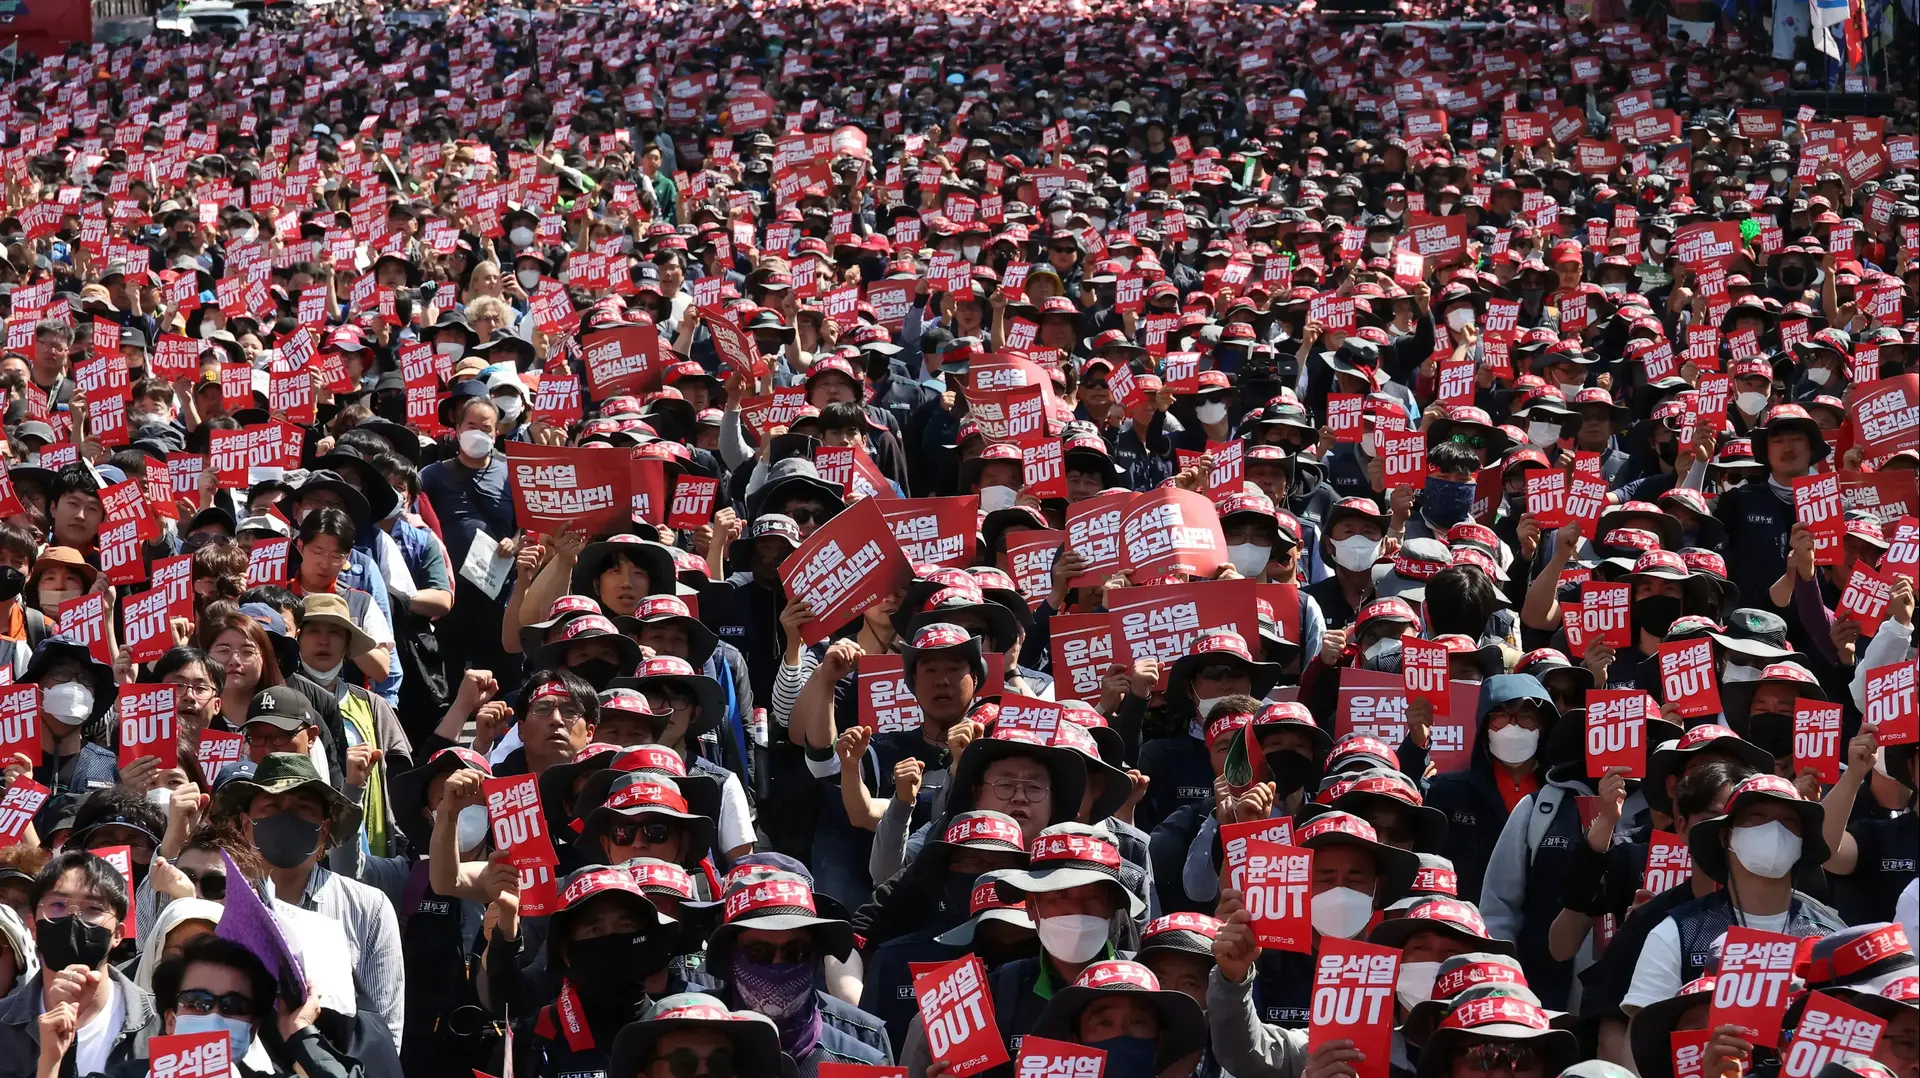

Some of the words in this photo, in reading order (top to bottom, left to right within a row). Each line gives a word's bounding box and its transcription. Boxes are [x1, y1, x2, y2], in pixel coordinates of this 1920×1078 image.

[766, 238, 790, 252] OUT
[897, 229, 920, 243] OUT
[793, 271, 814, 288] OUT
[830, 299, 856, 316] OUT
[1117, 291, 1141, 304] OUT
[1486, 316, 1515, 331] OUT
[1007, 333, 1032, 349] OUT
[1145, 331, 1167, 346] OUT
[1690, 341, 1716, 358] OUT
[402, 345, 432, 364] 윤석열
[1643, 343, 1672, 363] 윤석열
[222, 364, 251, 380] 윤석열
[404, 359, 432, 382] OUT
[1440, 364, 1474, 382] 윤석열
[1646, 360, 1675, 379] OUT
[223, 379, 250, 398] OUT
[279, 374, 310, 392] 윤석열
[408, 385, 435, 400] 윤석열
[1439, 378, 1473, 399] OUT
[90, 396, 123, 416] 윤석열
[279, 390, 310, 410] OUT
[408, 398, 436, 418] OUT
[535, 394, 565, 412] OUT
[773, 393, 805, 407] 윤석열
[1009, 396, 1042, 418] 윤석열
[1328, 398, 1363, 413] 윤석열
[1699, 396, 1727, 415] OUT
[1859, 391, 1907, 418] 윤석열
[91, 411, 122, 437] OUT
[1009, 413, 1041, 438] OUT
[1328, 411, 1361, 429] OUT
[210, 433, 246, 450] 윤석열
[248, 426, 283, 450] 윤석열
[1385, 436, 1424, 453] 윤석열
[41, 445, 77, 467] 윤석열
[210, 450, 247, 472] OUT
[249, 440, 283, 466] OUT
[816, 454, 853, 468] 윤석열
[1023, 440, 1061, 465] 윤석열
[1211, 441, 1243, 466] 윤석열
[1386, 451, 1423, 475] OUT
[146, 465, 170, 480] 윤석열
[168, 456, 203, 474] 윤석열
[517, 464, 578, 489] 윤석열
[1025, 457, 1062, 486] OUT
[1209, 458, 1242, 488] OUT
[149, 481, 171, 502] OUT
[170, 473, 202, 494] OUT
[676, 482, 717, 495] 윤석열
[1528, 473, 1564, 495] 윤석열
[1570, 480, 1605, 500] 윤석열
[1796, 476, 1838, 505] 윤석열
[102, 482, 141, 510] 윤석열
[524, 485, 614, 514] 정권심판!
[671, 496, 713, 514] OUT
[1528, 490, 1563, 515] OUT
[1566, 496, 1598, 518] OUT
[1799, 494, 1838, 527] OUT
[100, 522, 137, 545] 윤석열
[886, 515, 939, 540] 석열
[1069, 510, 1121, 546] 윤석열
[1124, 503, 1182, 545] 윤석열
[100, 540, 137, 567] OUT
[250, 541, 288, 562] 윤석열
[1129, 525, 1215, 563] 정권심판!
[1887, 542, 1918, 563] OU
[152, 558, 191, 588] 윤석열
[247, 559, 286, 584] OUT
[791, 540, 845, 595] 윤석열
[803, 540, 886, 615] 정권심판!
[166, 583, 187, 605] UT
[1849, 570, 1892, 600] 윤석열
[124, 589, 168, 622] 윤석열
[1583, 586, 1628, 609] 윤석열
[1841, 590, 1887, 619] OUT
[60, 596, 102, 626] 윤석열
[1122, 602, 1199, 640] 윤석열
[1369, 603, 1392, 616] 단결
[1583, 607, 1628, 631] OUT
[125, 613, 167, 646] OUT
[1196, 634, 1221, 652] 단결
[1405, 648, 1446, 666] 윤석열
[1661, 644, 1711, 673] 윤석열
[1406, 667, 1444, 690] OUT
[1664, 664, 1710, 700] OUT
[1867, 669, 1914, 699] 윤석열
[121, 688, 174, 718] 윤석열
[1350, 696, 1408, 722] 윤석
[1588, 695, 1644, 724] 윤석열
[1868, 687, 1915, 726] OUT
[122, 711, 174, 746] OUT
[998, 706, 1058, 730] 윤석열
[1211, 720, 1231, 737] 단결
[1795, 709, 1840, 731] 윤석열
[199, 738, 241, 760] 윤석열
[1588, 720, 1643, 756] OUT
[1795, 732, 1838, 758] OUT
[650, 752, 672, 770] 단결
[6, 787, 47, 812] 윤석열
[488, 779, 537, 818] 윤석열
[1178, 788, 1210, 797] 단결투쟁
[494, 807, 541, 850] OUT
[947, 822, 970, 842] 단결
[1304, 825, 1334, 840] 단결
[1068, 838, 1103, 858] 투쟁
[1247, 854, 1308, 882] 윤석열
[1882, 861, 1913, 869] 단결투쟁
[727, 890, 750, 917] 단결
[1246, 884, 1308, 920] OUT
[1722, 942, 1796, 970] 윤석열
[1855, 934, 1892, 961] 단결
[1317, 954, 1397, 985] 윤석열
[1439, 967, 1466, 993] 단결
[920, 960, 979, 1024] 윤석열
[1715, 973, 1788, 1008] OUT
[1269, 1009, 1310, 1019] 단결투쟁
[1313, 987, 1389, 1025] OUT
[1459, 1000, 1495, 1026] 단결
[929, 990, 986, 1058] OUT
[1800, 1010, 1882, 1050] 윤석열
